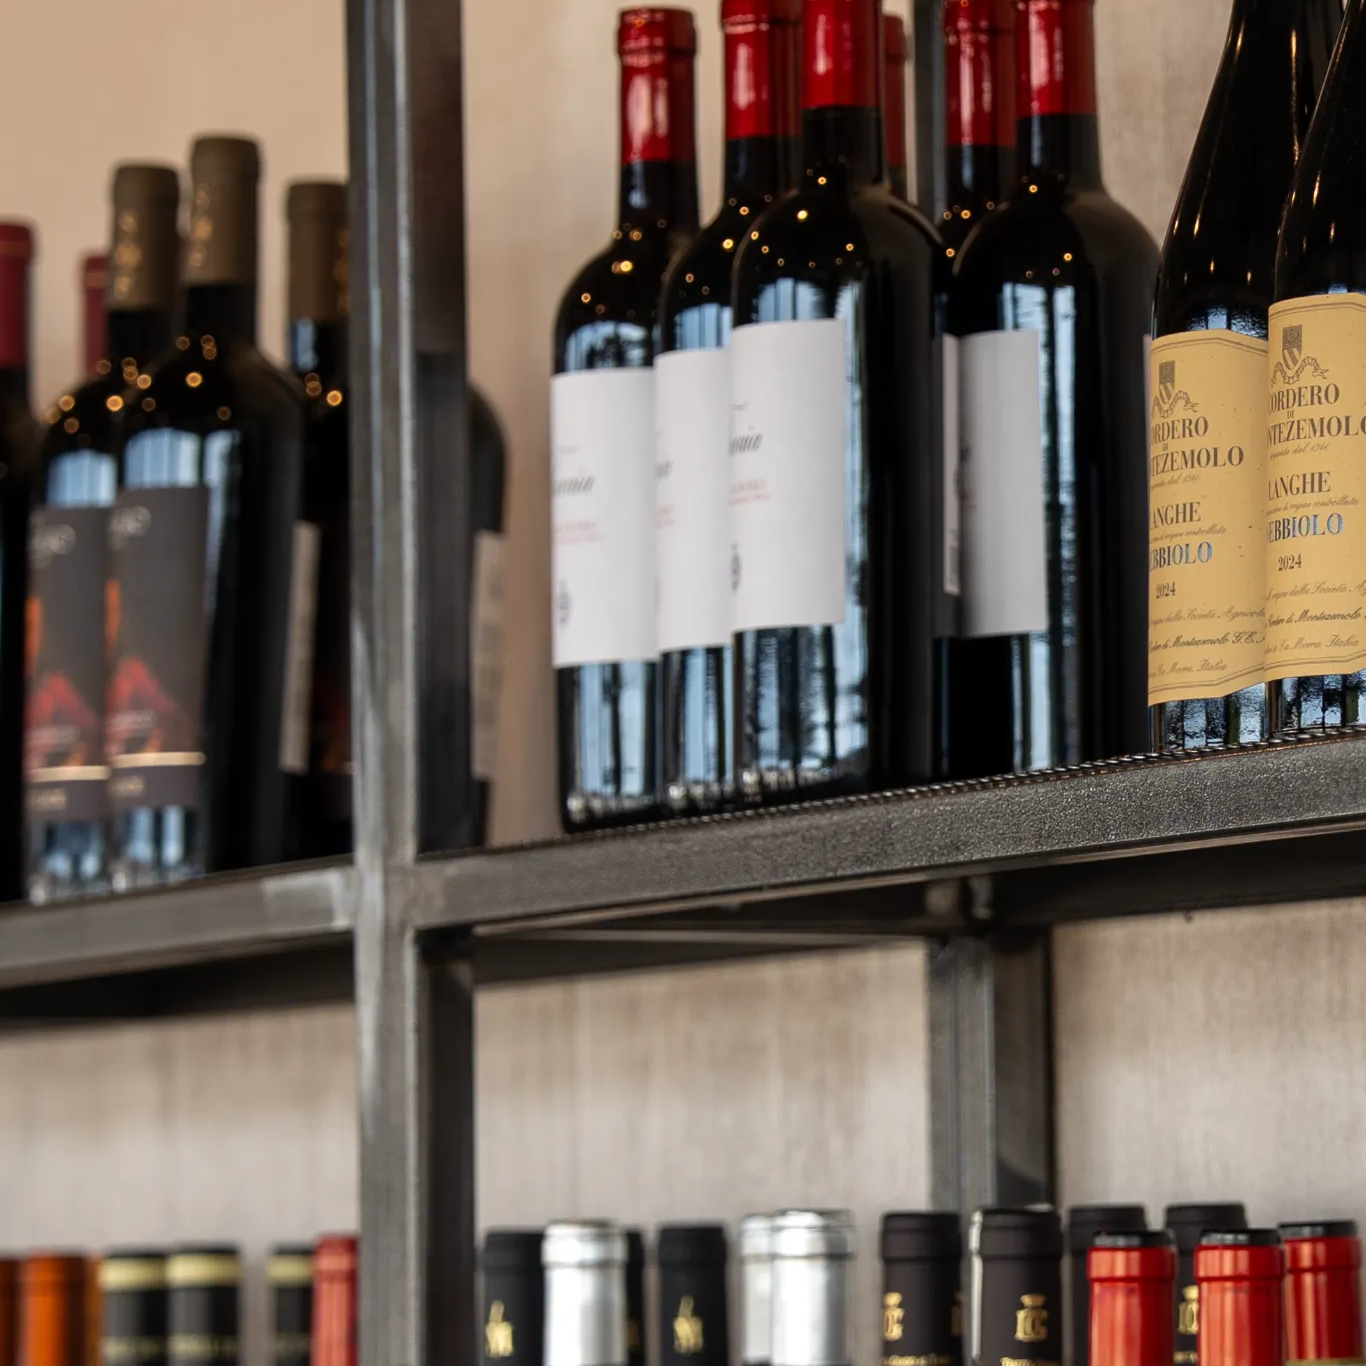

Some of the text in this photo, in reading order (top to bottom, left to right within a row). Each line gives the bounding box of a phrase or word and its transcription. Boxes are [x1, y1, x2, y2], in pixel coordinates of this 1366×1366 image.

[1153, 416, 1209, 444] RDERO
[1268, 471, 1331, 501] LANGHE
[1151, 501, 1201, 530] ANGHE
[1278, 553, 1302, 571] 2024
[1156, 581, 1176, 599] 2024
